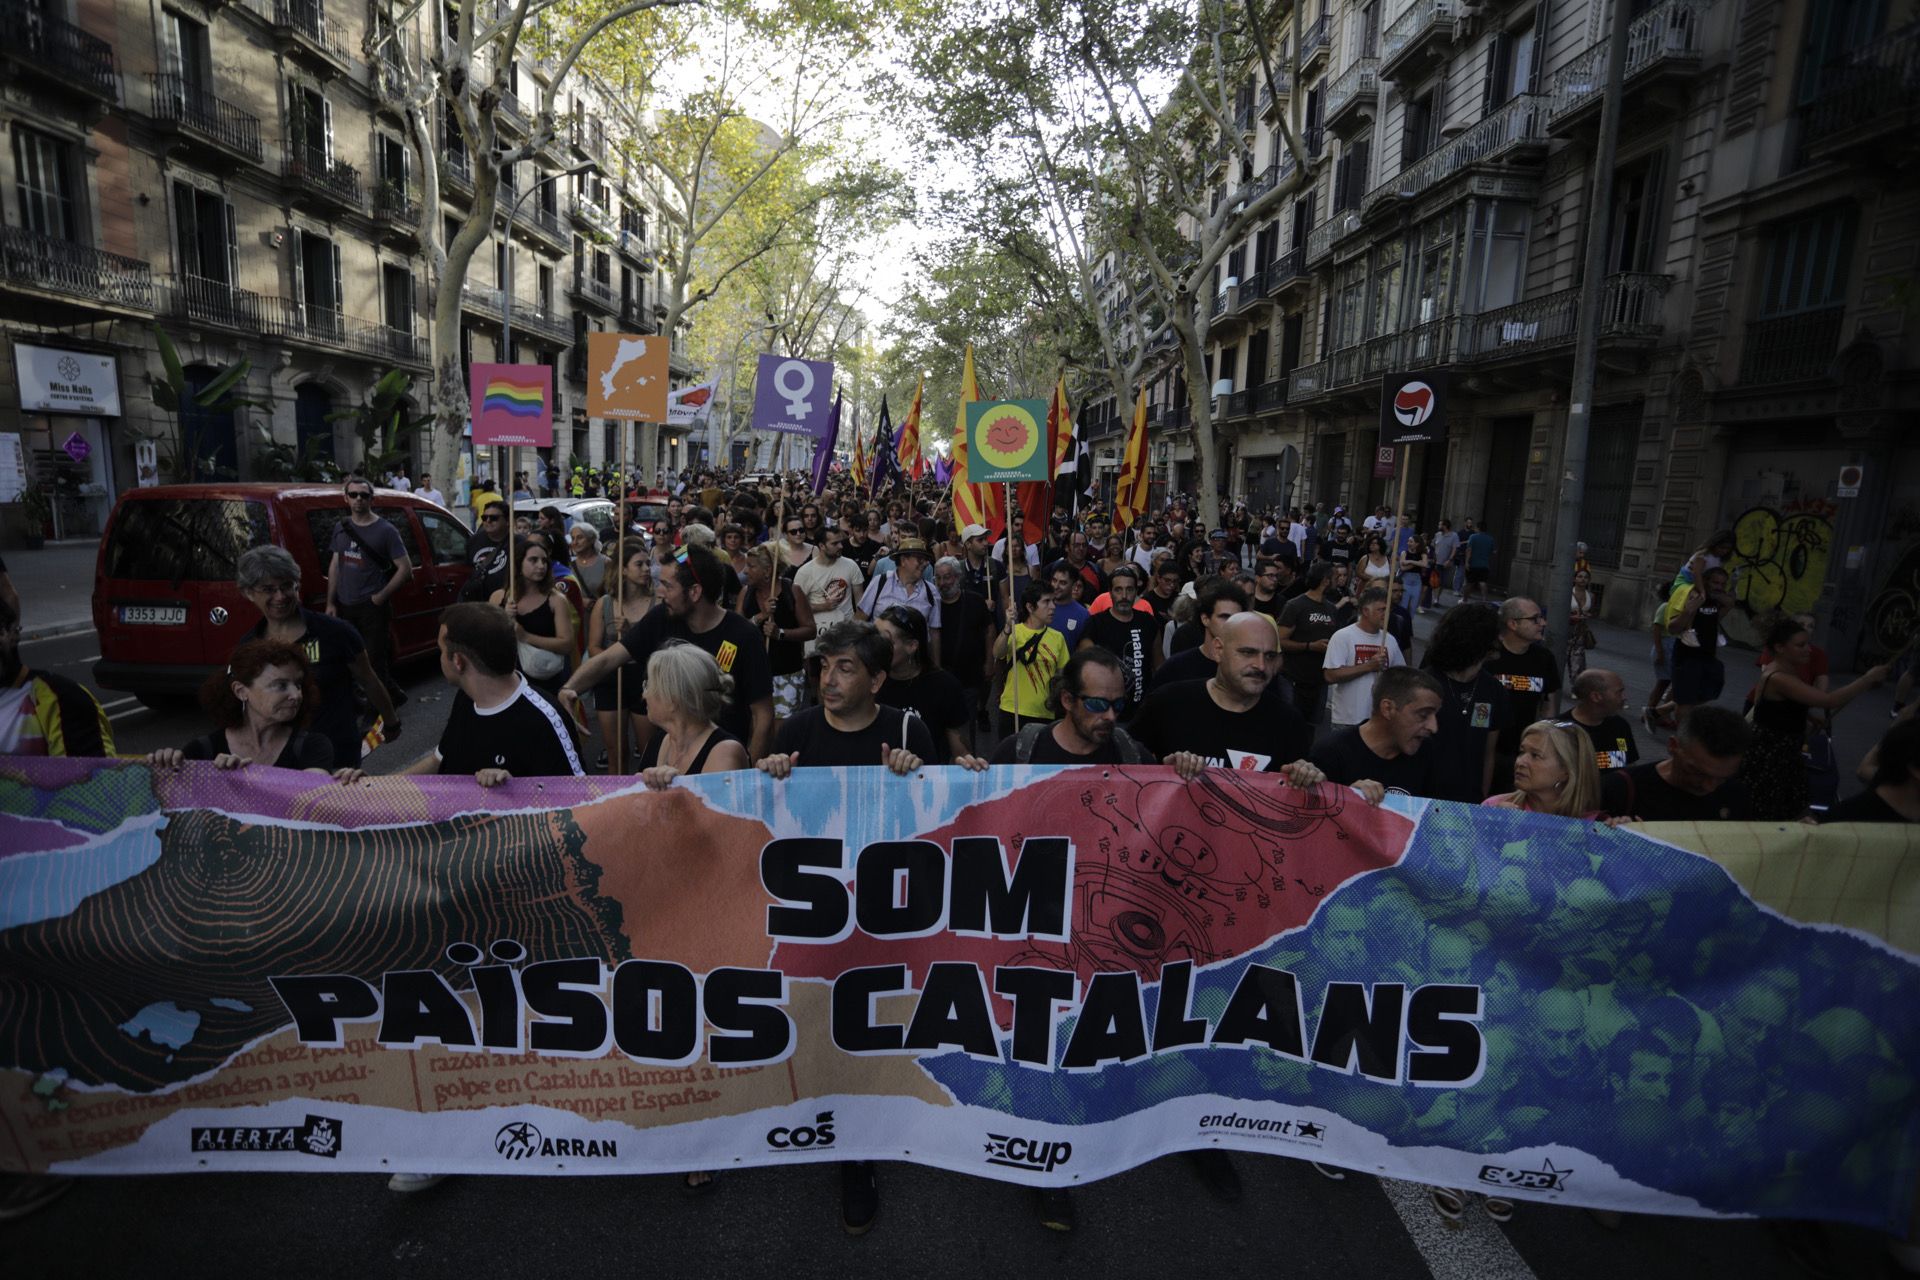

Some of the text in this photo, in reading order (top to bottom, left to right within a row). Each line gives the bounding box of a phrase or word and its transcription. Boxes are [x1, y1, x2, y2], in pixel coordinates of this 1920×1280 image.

[50, 382, 93, 395] Miss Nails
[128, 607, 183, 621] 3353 JJC
[1130, 628, 1145, 702] inadaptats
[1104, 793, 1118, 805] 16
[760, 836, 1075, 943] SOM
[268, 939, 1487, 1088] PAÏSOS CATALANS
[230, 1044, 308, 1070] nchez
[429, 1052, 490, 1072] razón
[493, 1053, 506, 1067] a
[277, 1074, 291, 1090] a
[434, 1077, 490, 1106] golpe
[495, 1078, 522, 1094] en
[524, 1069, 615, 1091] Cataluña
[702, 1067, 715, 1082] a
[1199, 1112, 1292, 1134] endavant
[197, 1128, 296, 1144] ALERTA
[541, 1138, 617, 1158] ARRAN
